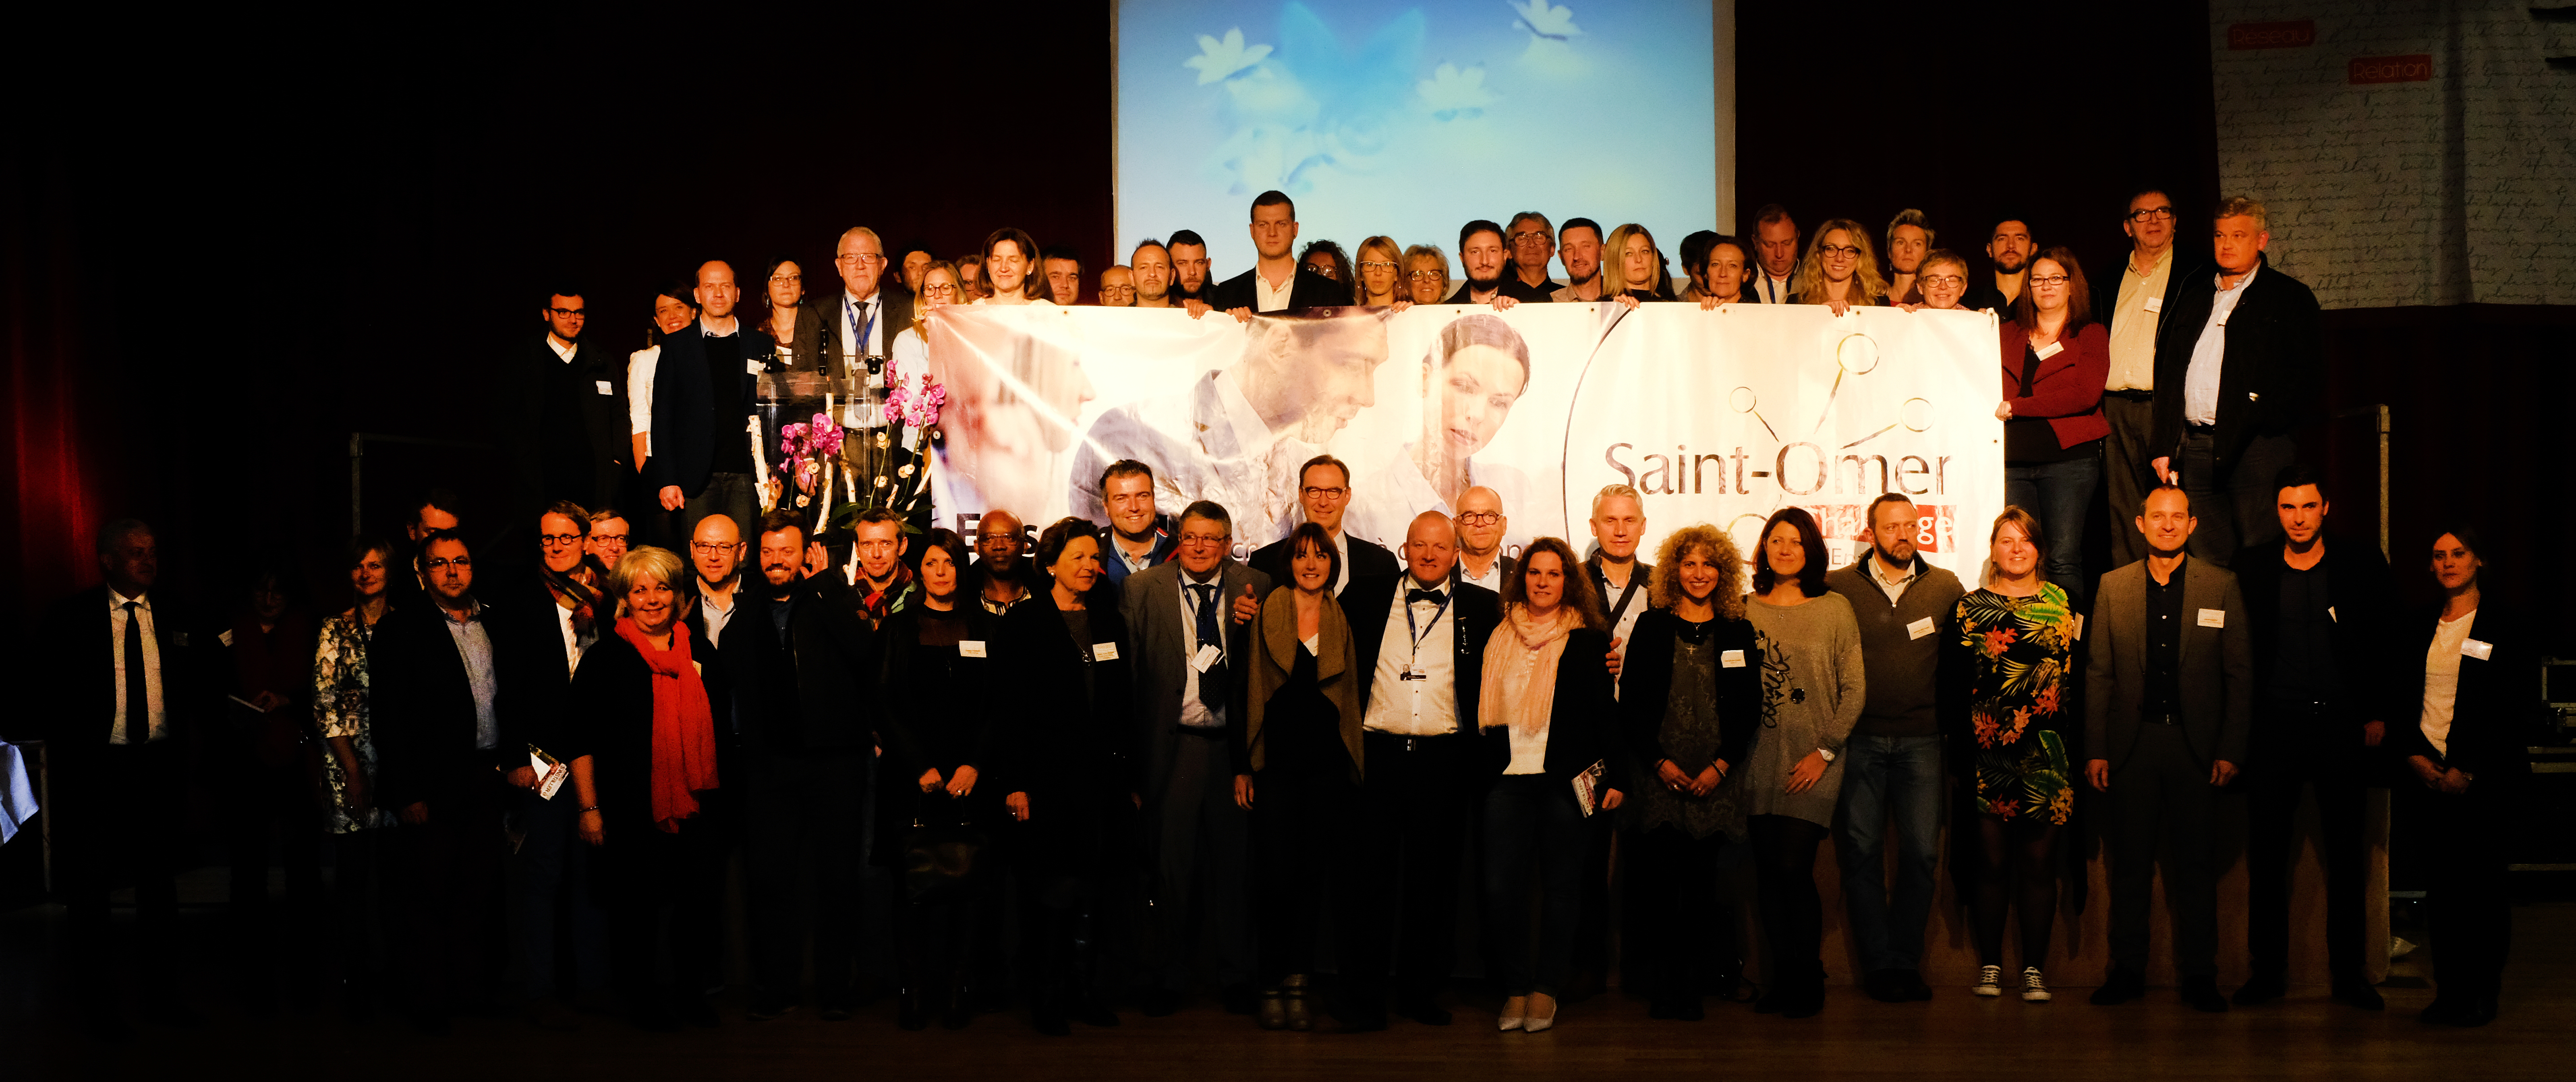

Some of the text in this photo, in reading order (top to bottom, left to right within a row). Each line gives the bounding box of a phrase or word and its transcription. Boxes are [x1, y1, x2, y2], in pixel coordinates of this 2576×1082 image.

[2233, 28, 2309, 45] Réseau
[2354, 61, 2427, 80] Relation
[1605, 441, 1953, 495] Saint-Omer
